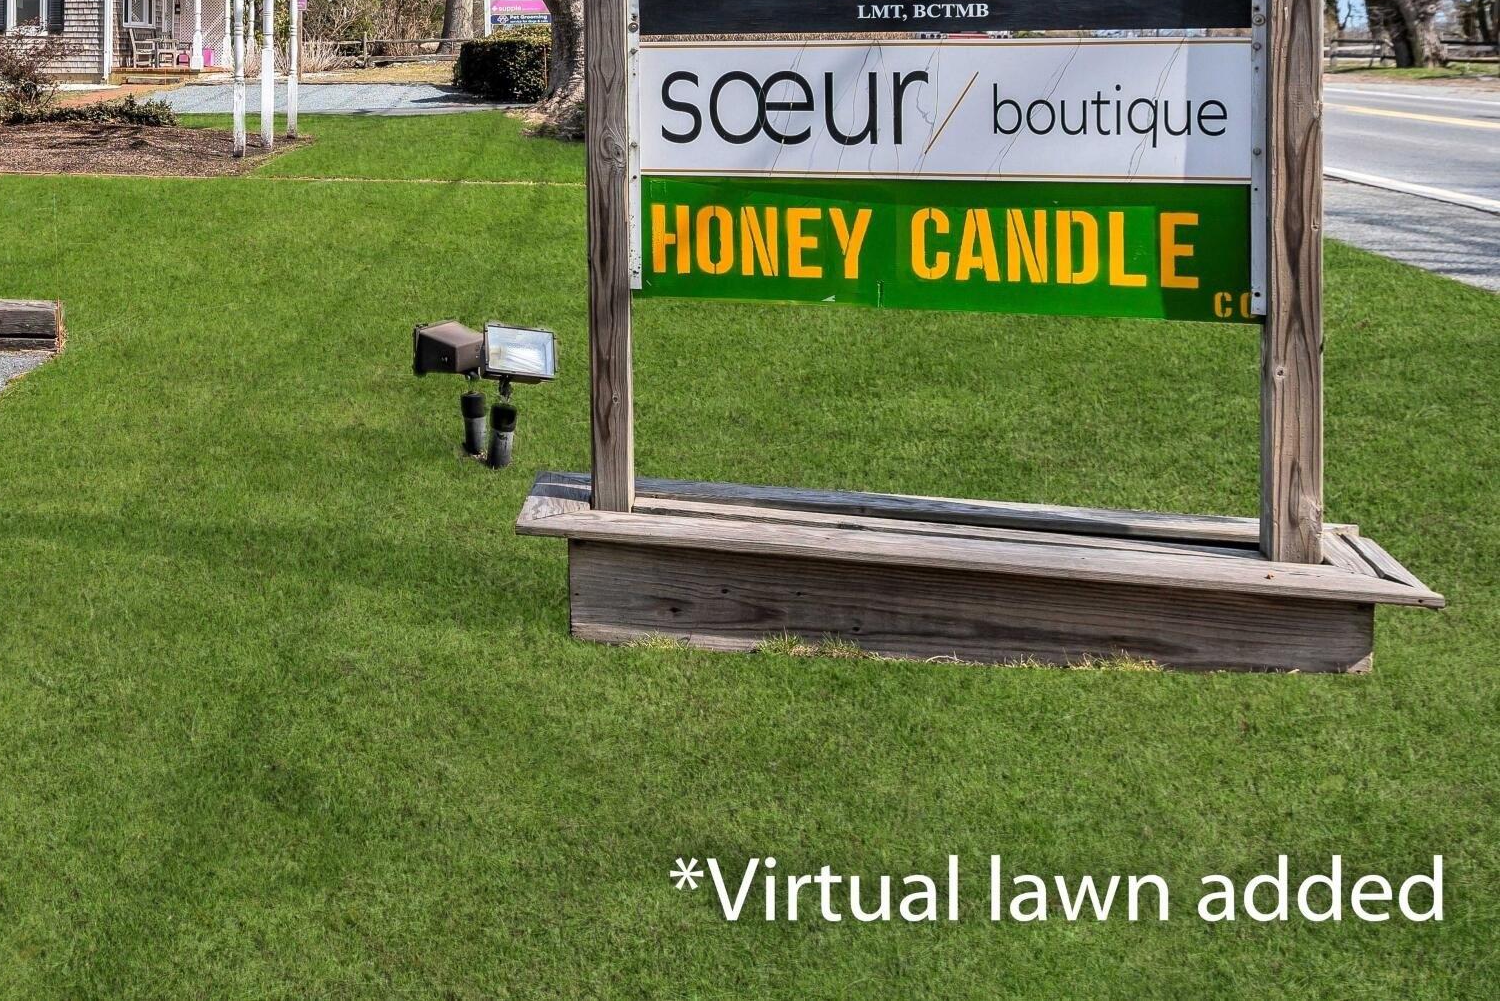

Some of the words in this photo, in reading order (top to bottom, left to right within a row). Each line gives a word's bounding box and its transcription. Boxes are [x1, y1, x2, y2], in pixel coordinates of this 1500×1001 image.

[856, 4, 908, 22] LMT,
[912, 3, 990, 20] BCTMB
[991, 83, 1229, 148] boutique
[651, 203, 874, 280] HONEY
[910, 207, 1201, 290] CANDLE
